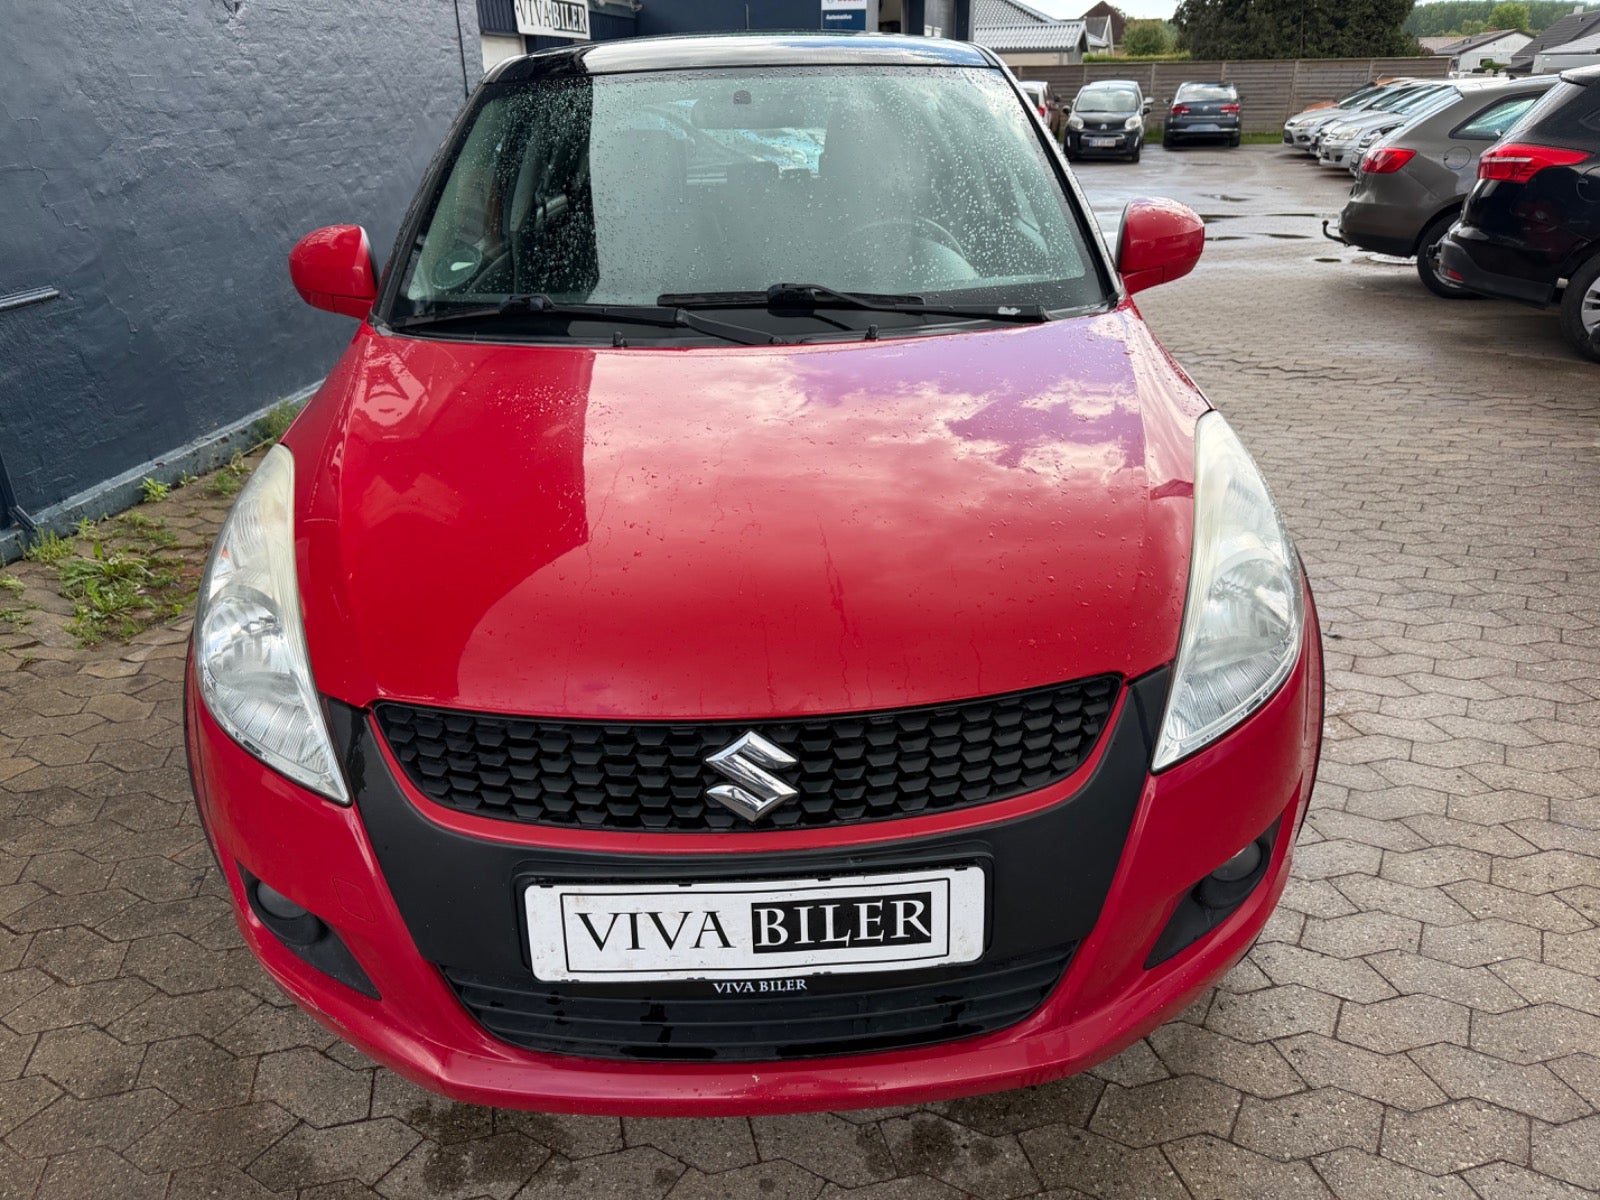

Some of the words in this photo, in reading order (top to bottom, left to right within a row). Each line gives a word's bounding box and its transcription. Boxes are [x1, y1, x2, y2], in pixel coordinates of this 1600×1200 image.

[517, 0, 552, 28] VIVA
[552, 1, 587, 33] BILER
[575, 911, 737, 951] VIVA
[754, 899, 932, 948] BILER
[713, 982, 755, 993] VIVA
[759, 979, 807, 992] BILER
